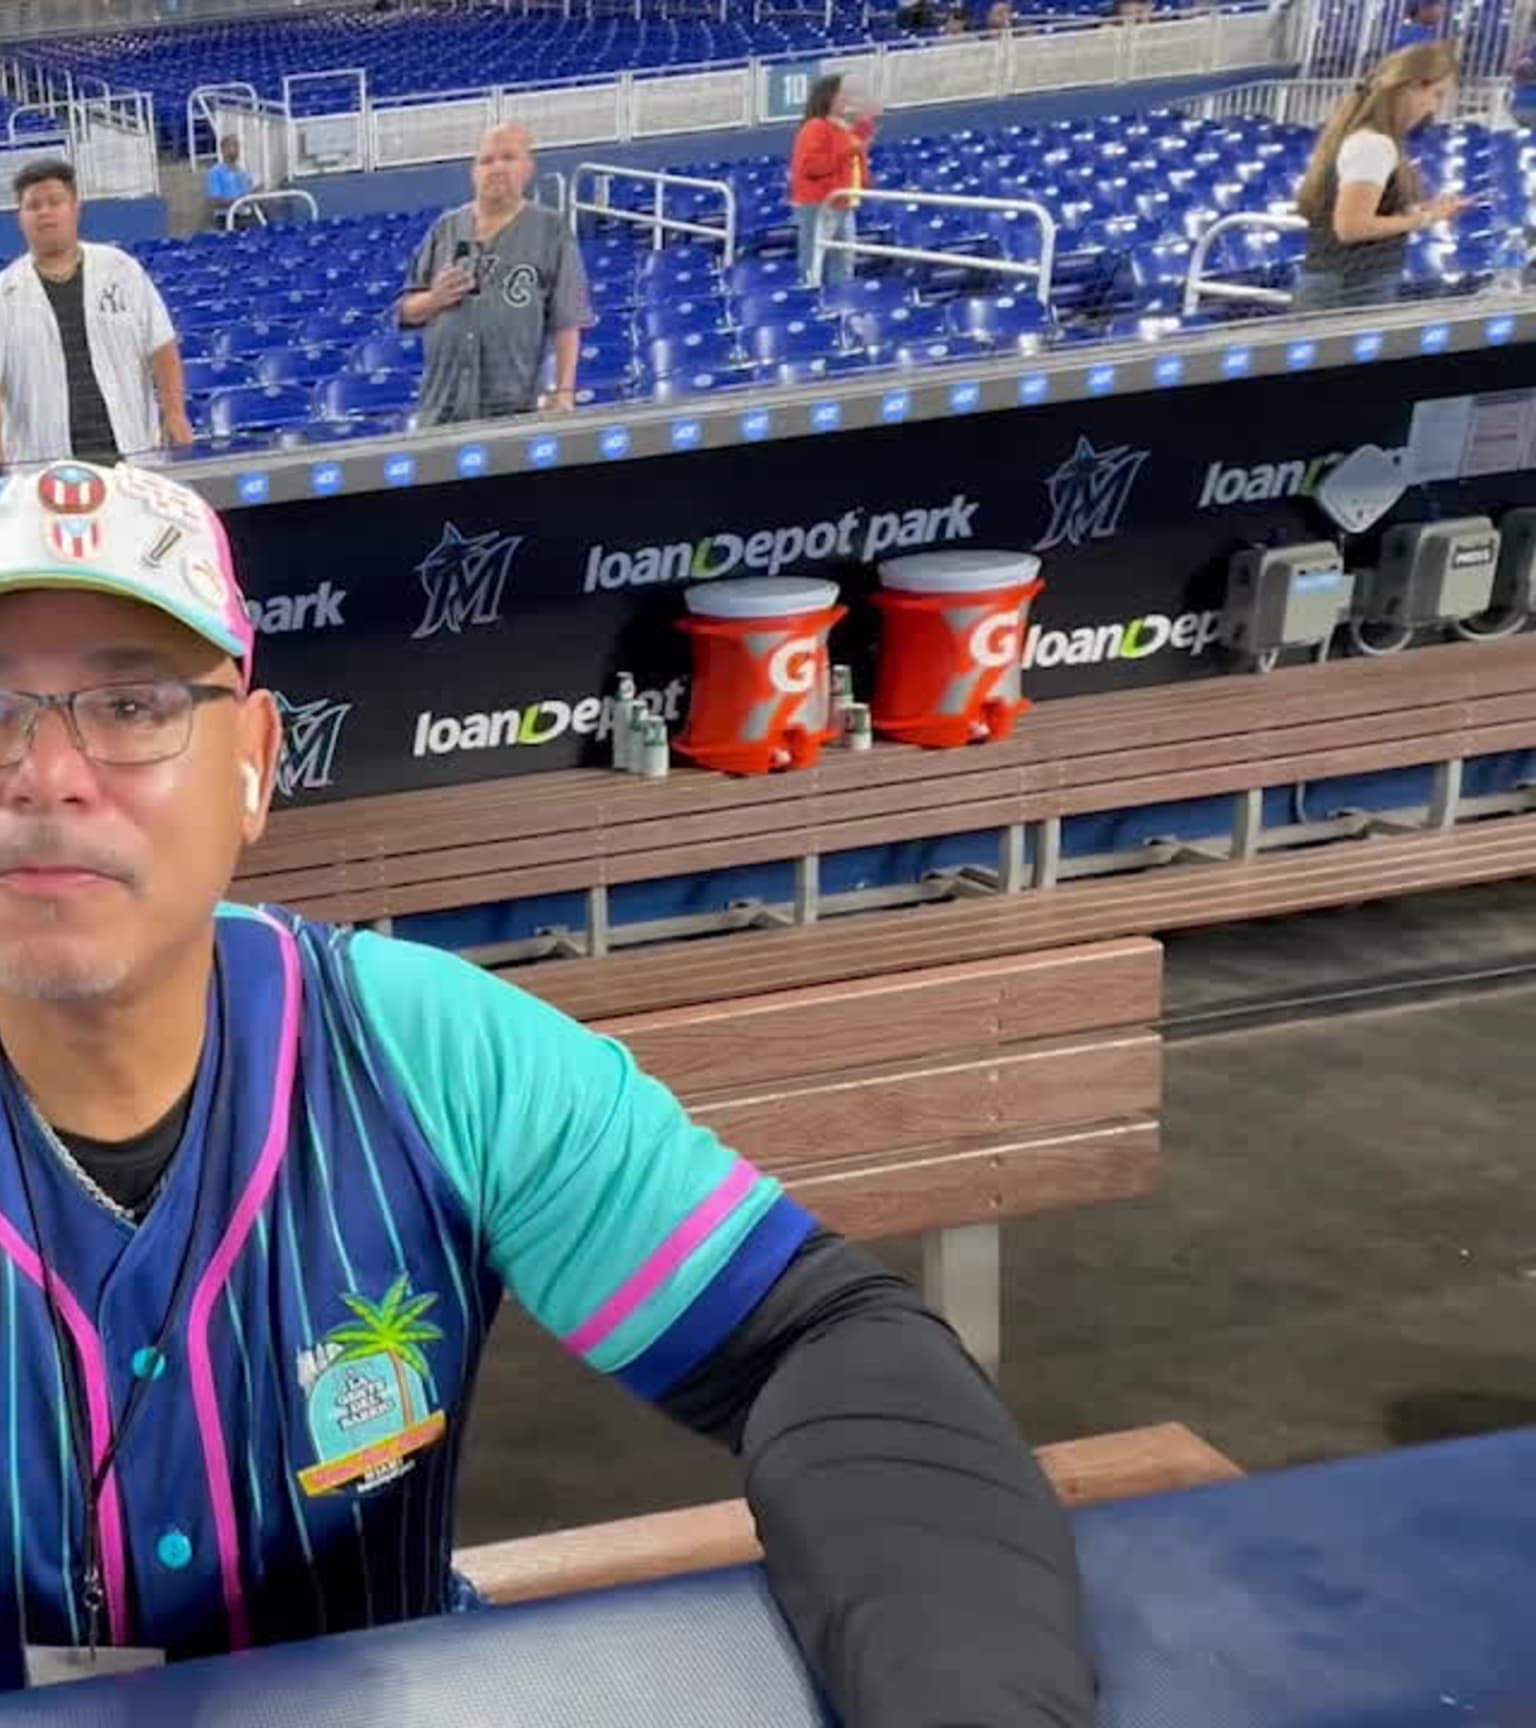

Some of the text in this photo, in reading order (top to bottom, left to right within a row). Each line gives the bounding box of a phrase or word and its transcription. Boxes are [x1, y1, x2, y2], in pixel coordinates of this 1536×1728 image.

[784, 73, 807, 105] 10
[583, 495, 980, 593] loanDepot park
[768, 636, 816, 693] G
[969, 610, 1019, 668] G
